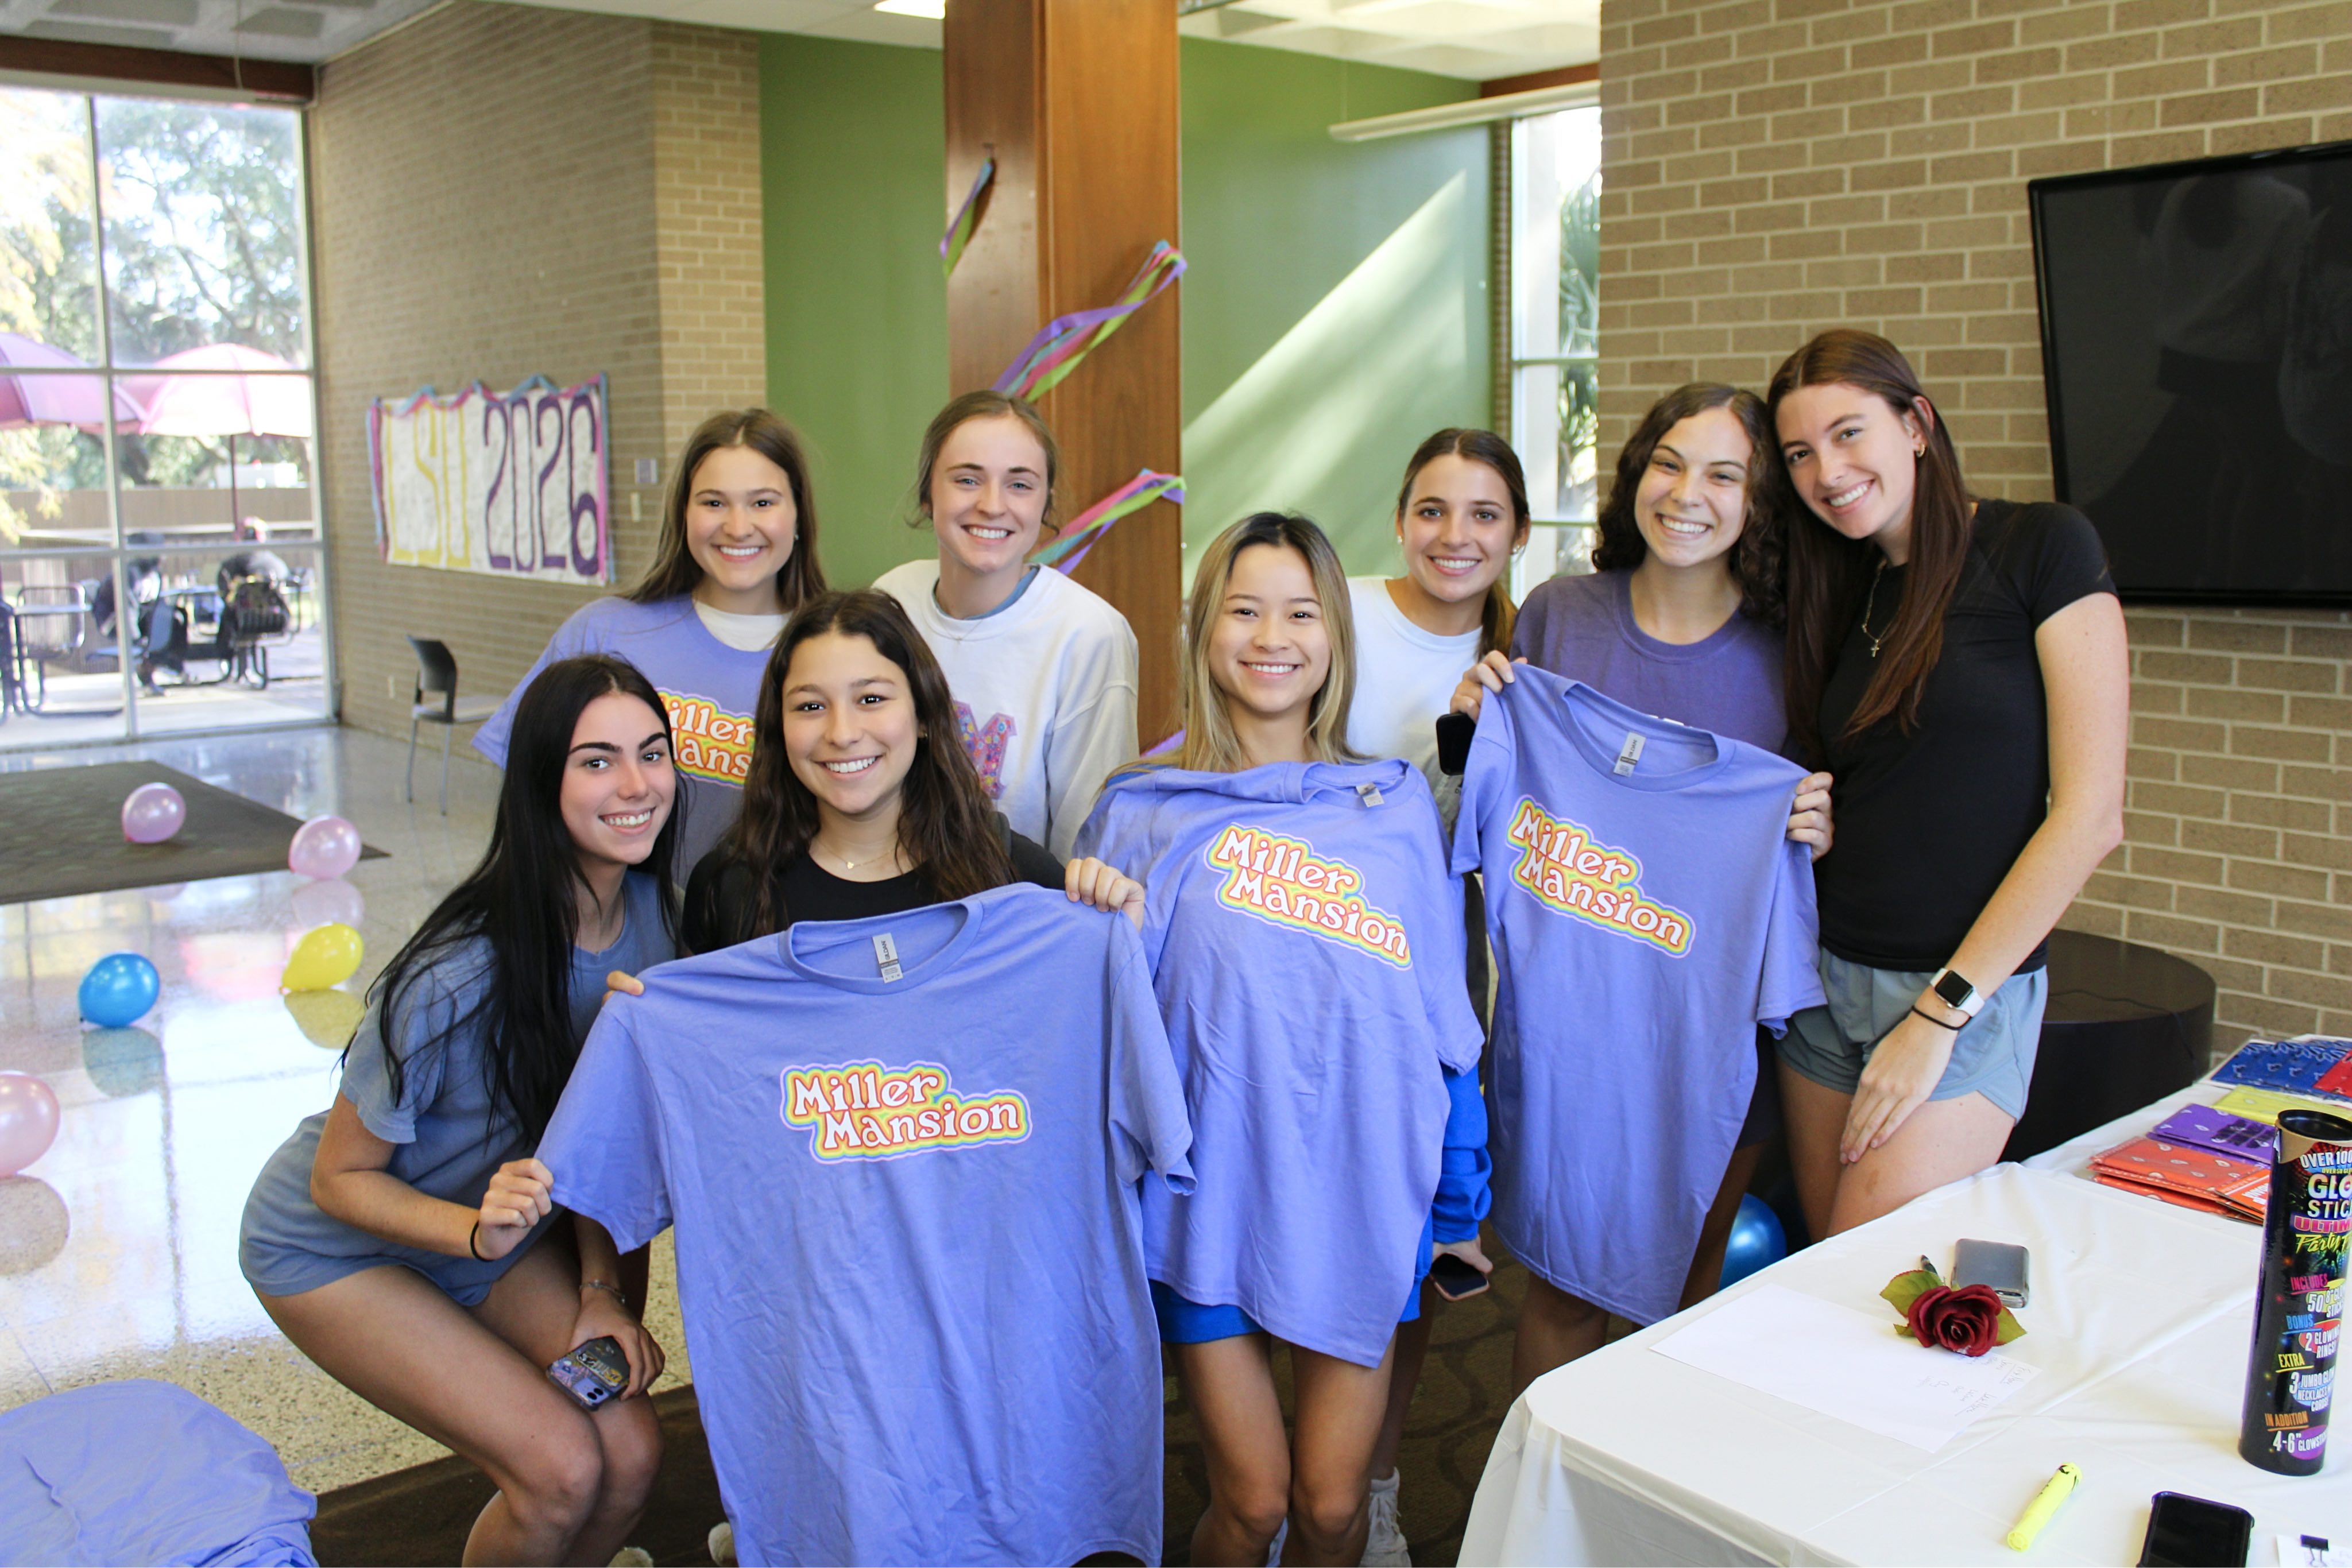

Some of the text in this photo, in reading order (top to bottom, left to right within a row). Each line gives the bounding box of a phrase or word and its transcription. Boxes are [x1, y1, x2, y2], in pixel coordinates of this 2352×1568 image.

[384, 394, 599, 576] LSU 2026
[665, 702, 755, 745] iller
[671, 729, 753, 777] ans
[1217, 830, 1353, 894] Miller
[1513, 808, 1630, 884] Miller
[1228, 868, 1407, 957] Mansion
[1521, 848, 1683, 946] Mansion
[794, 1071, 939, 1115] Miller
[823, 1102, 1019, 1149] Mansion
[2299, 1152, 2334, 1168] OVER
[2307, 1199, 2352, 1219] STIC
[2291, 1273, 2328, 1291] INCLUDES
[2307, 1293, 2324, 1313] 50
[2286, 1314, 2314, 1330] BONUS
[2305, 1332, 2312, 1352] 2
[2278, 1352, 2305, 1368] EXTRA
[2289, 1371, 2299, 1394] 3
[2300, 1373, 2322, 1388] JUMBO
[2265, 1411, 2308, 1427] IN ADDITION
